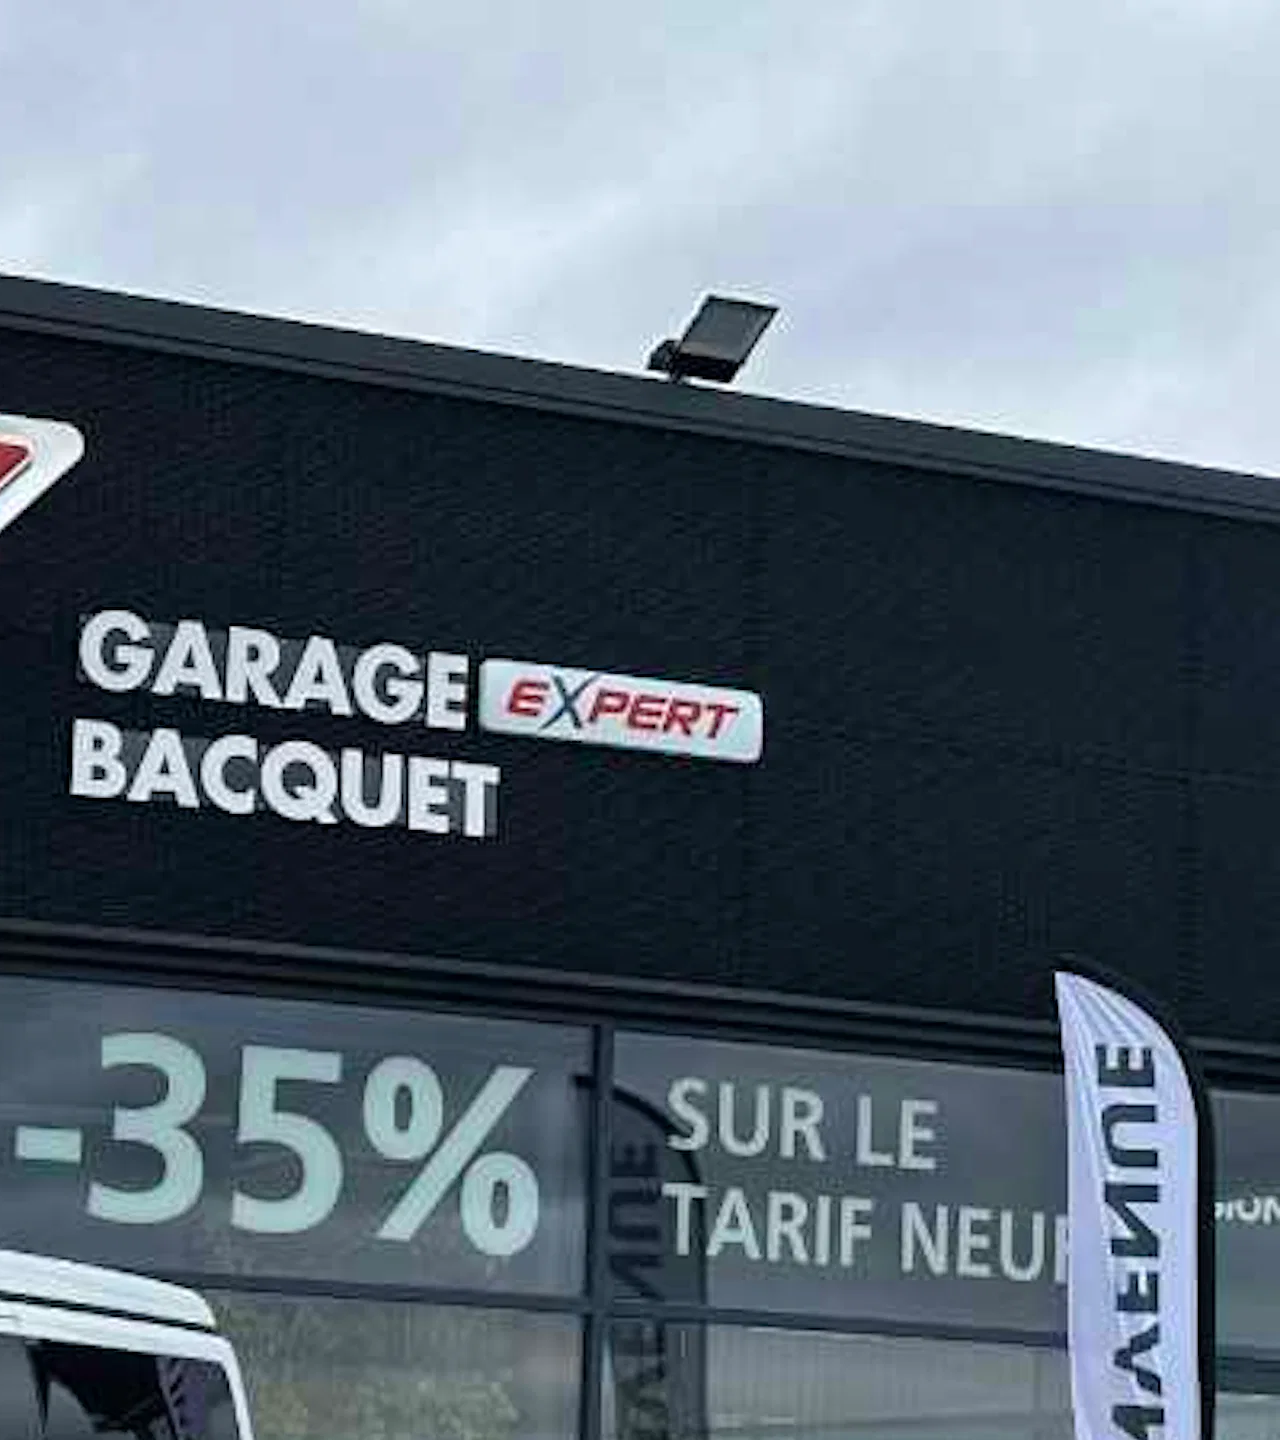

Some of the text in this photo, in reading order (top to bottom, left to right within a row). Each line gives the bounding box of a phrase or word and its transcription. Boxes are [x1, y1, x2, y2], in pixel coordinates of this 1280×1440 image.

[78, 610, 470, 732] GARAGE
[507, 674, 739, 740] EXPERT
[69, 718, 501, 838] BACQUET
[15, 1032, 540, 1257] -35%
[666, 1077, 939, 1170] SUR LE
[661, 1183, 873, 1267] TARIF
